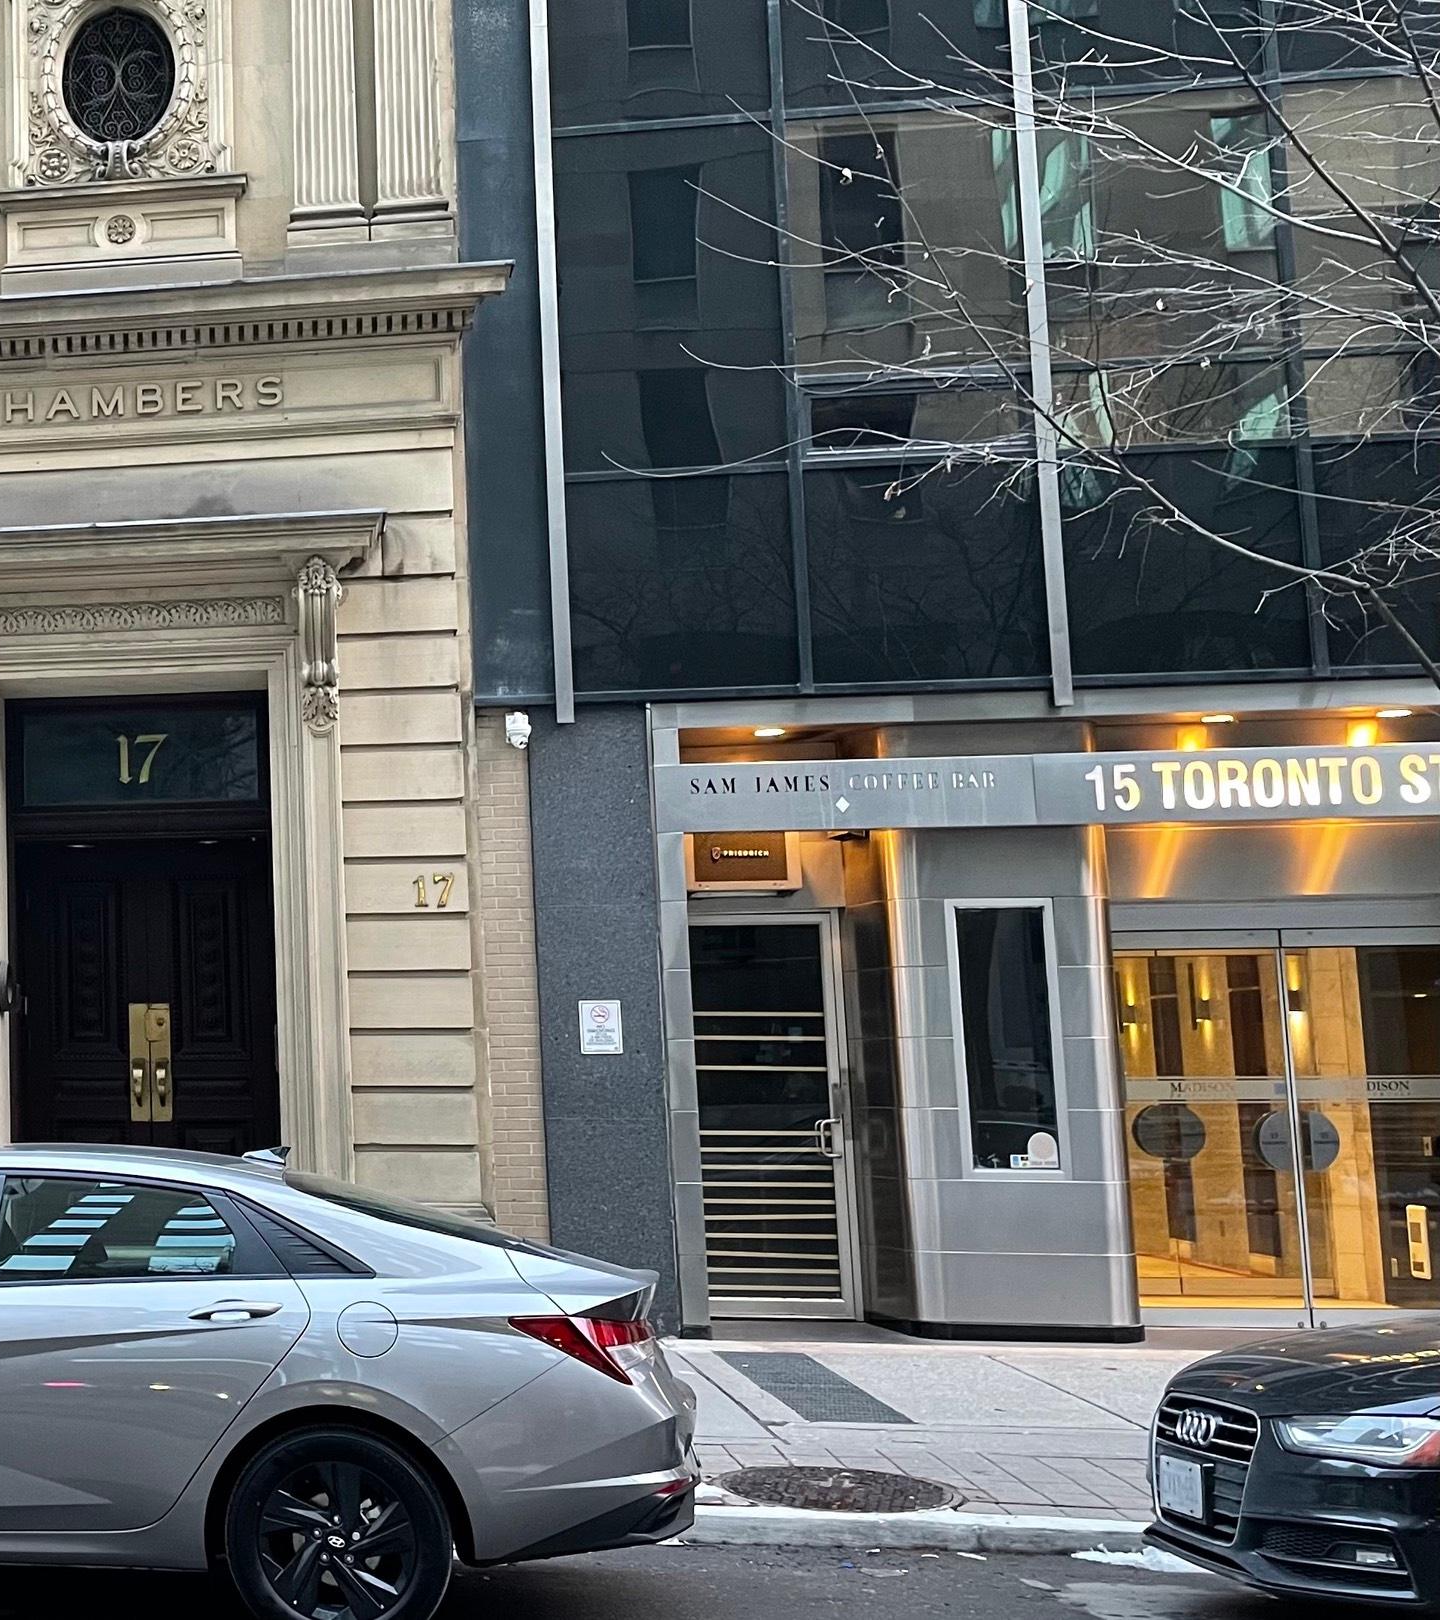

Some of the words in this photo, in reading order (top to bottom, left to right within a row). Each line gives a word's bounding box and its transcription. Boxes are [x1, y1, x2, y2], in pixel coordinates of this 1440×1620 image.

[116, 733, 169, 784] 17
[690, 777, 736, 795] SAM
[755, 775, 830, 793] JAMES
[848, 771, 939, 790] COFFEE
[952, 770, 995, 789] BAR
[1085, 764, 1141, 811] 15
[1152, 756, 1382, 810] TORONTO
[412, 873, 454, 909] 17
[1367, 1080, 1410, 1092] DISON
